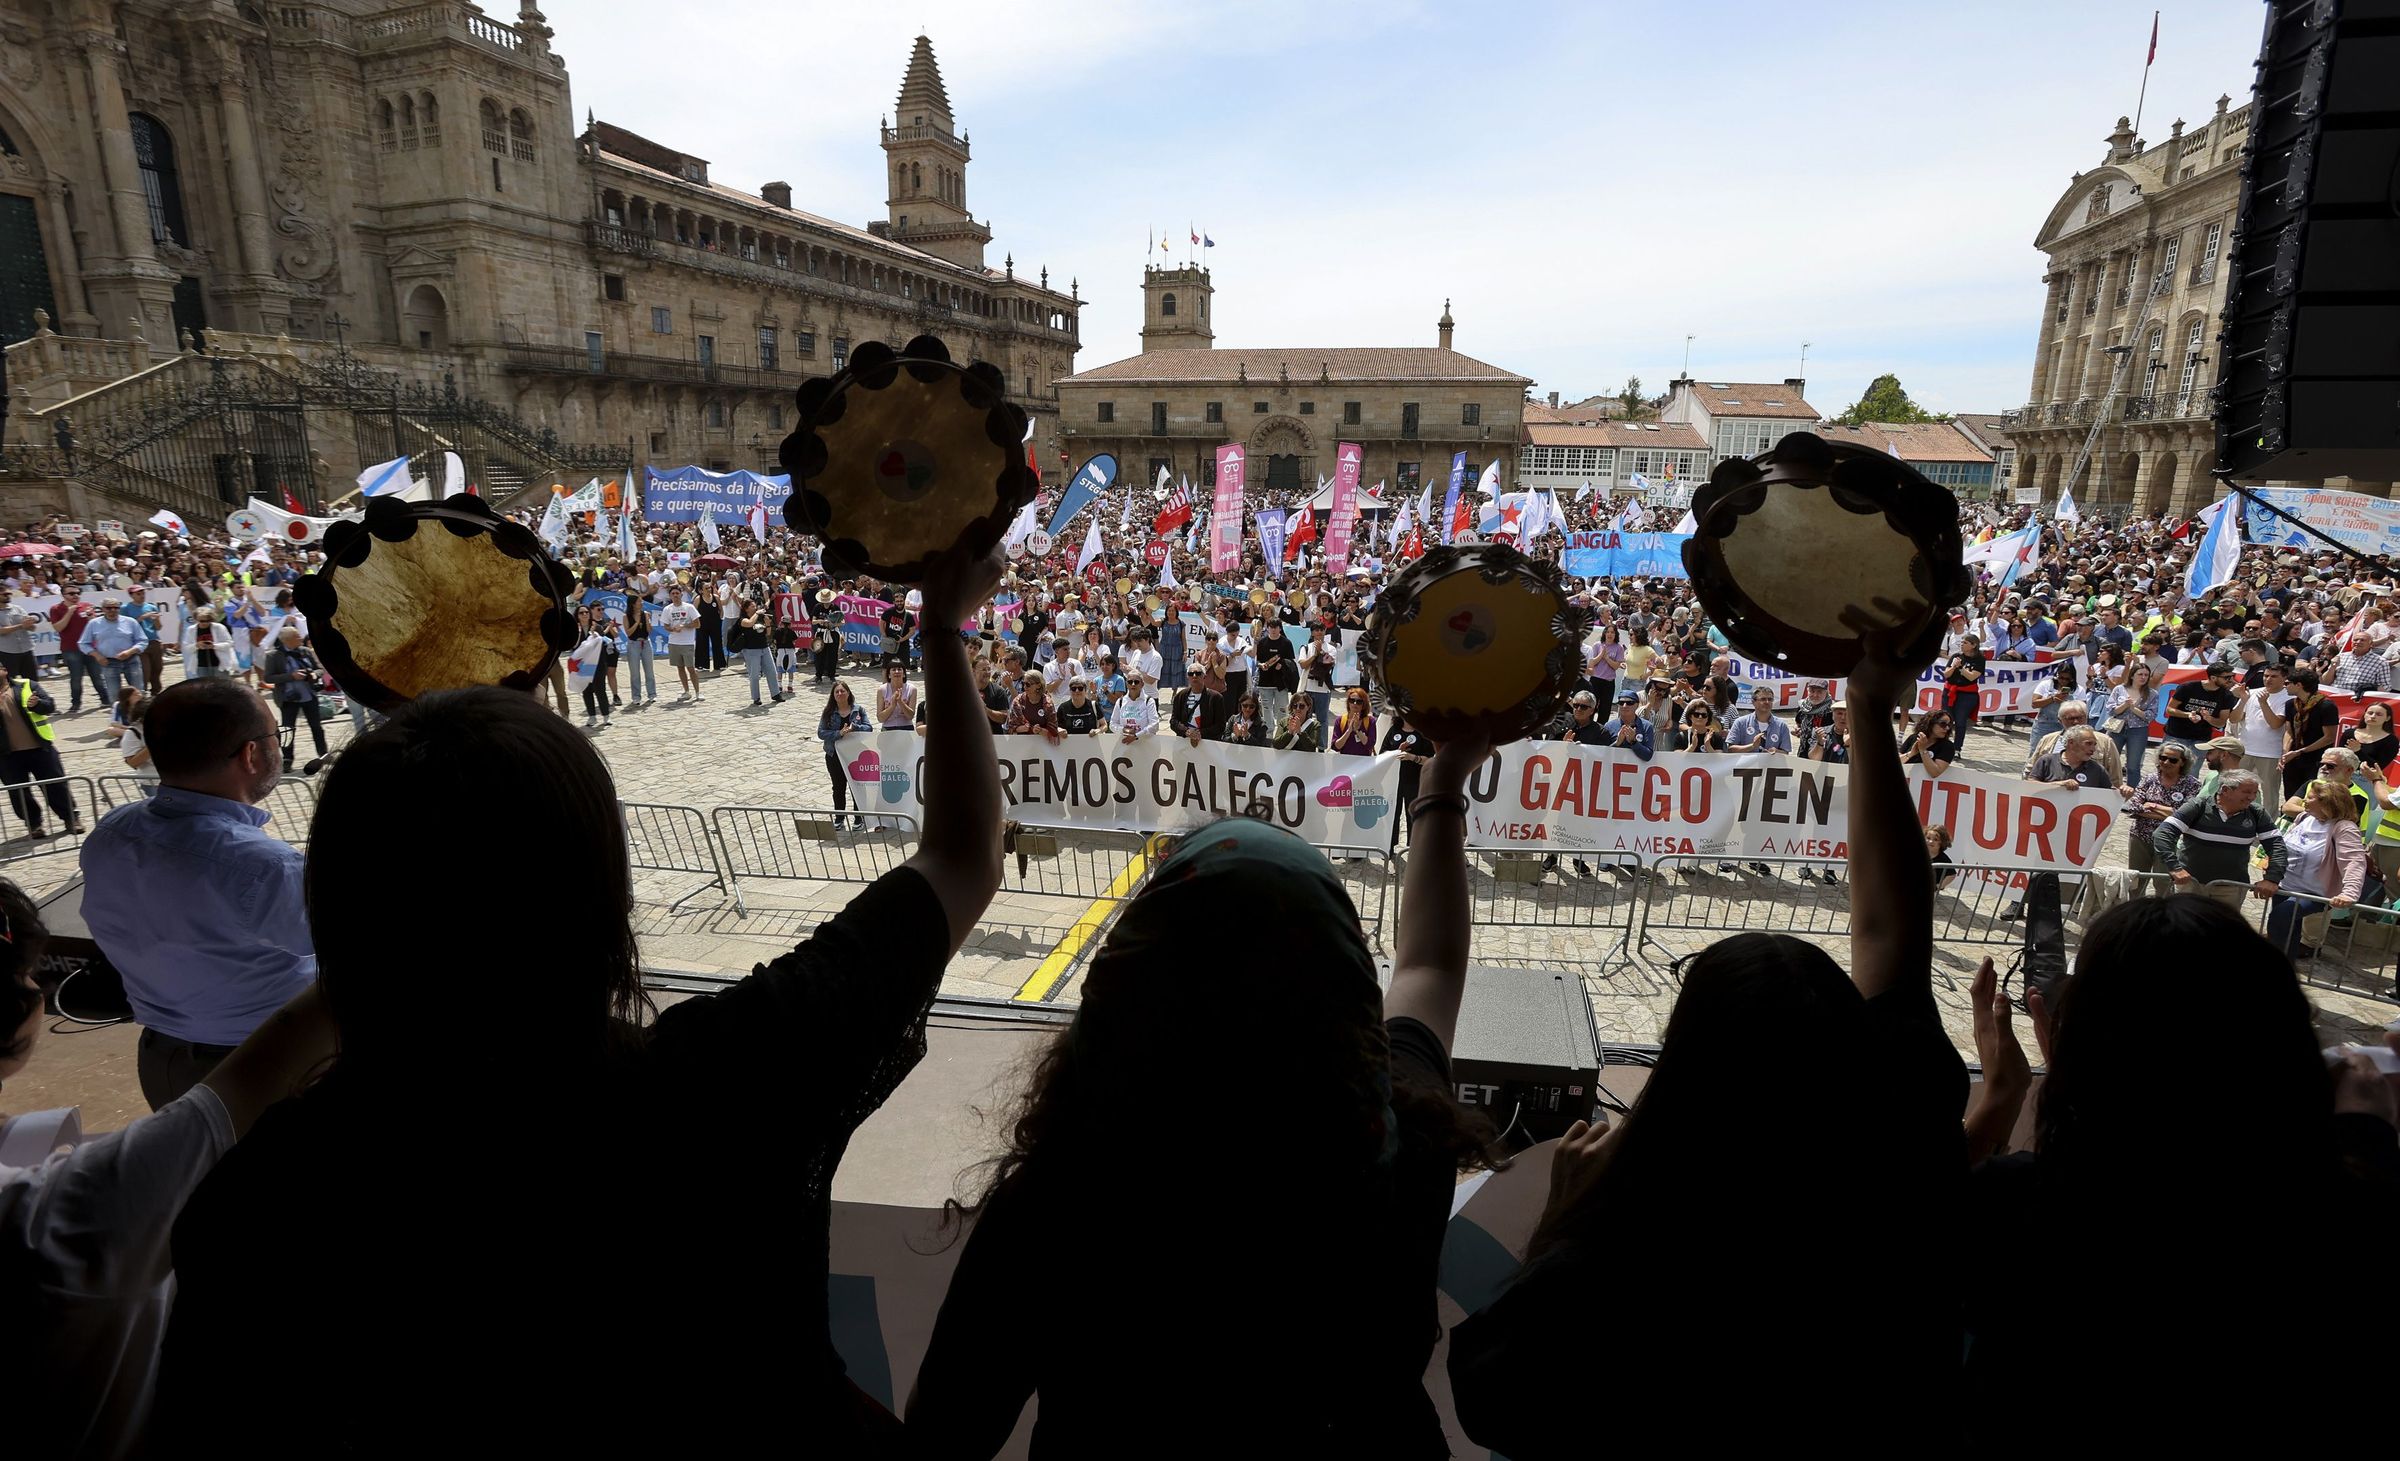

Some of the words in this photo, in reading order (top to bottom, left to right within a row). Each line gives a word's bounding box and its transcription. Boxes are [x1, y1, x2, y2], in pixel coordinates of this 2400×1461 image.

[650, 478, 722, 495] Precisamos
[726, 481, 744, 495] da
[749, 480, 790, 499] lingua
[651, 500, 663, 511] se
[667, 500, 733, 514] queremos
[1565, 532, 1622, 550] LINGUA
[859, 764, 901, 772] QUEREMOS
[1151, 757, 1306, 828] GALEGO
[1329, 788, 1375, 798] QUEREMOS
[1519, 754, 1712, 825] GALEGO
[1732, 767, 1836, 826] TEN
[1354, 798, 1388, 807] GALEGO
[1488, 820, 1548, 841] MESA
[1634, 835, 1696, 855] MESA
[1784, 838, 1849, 860] MESA
